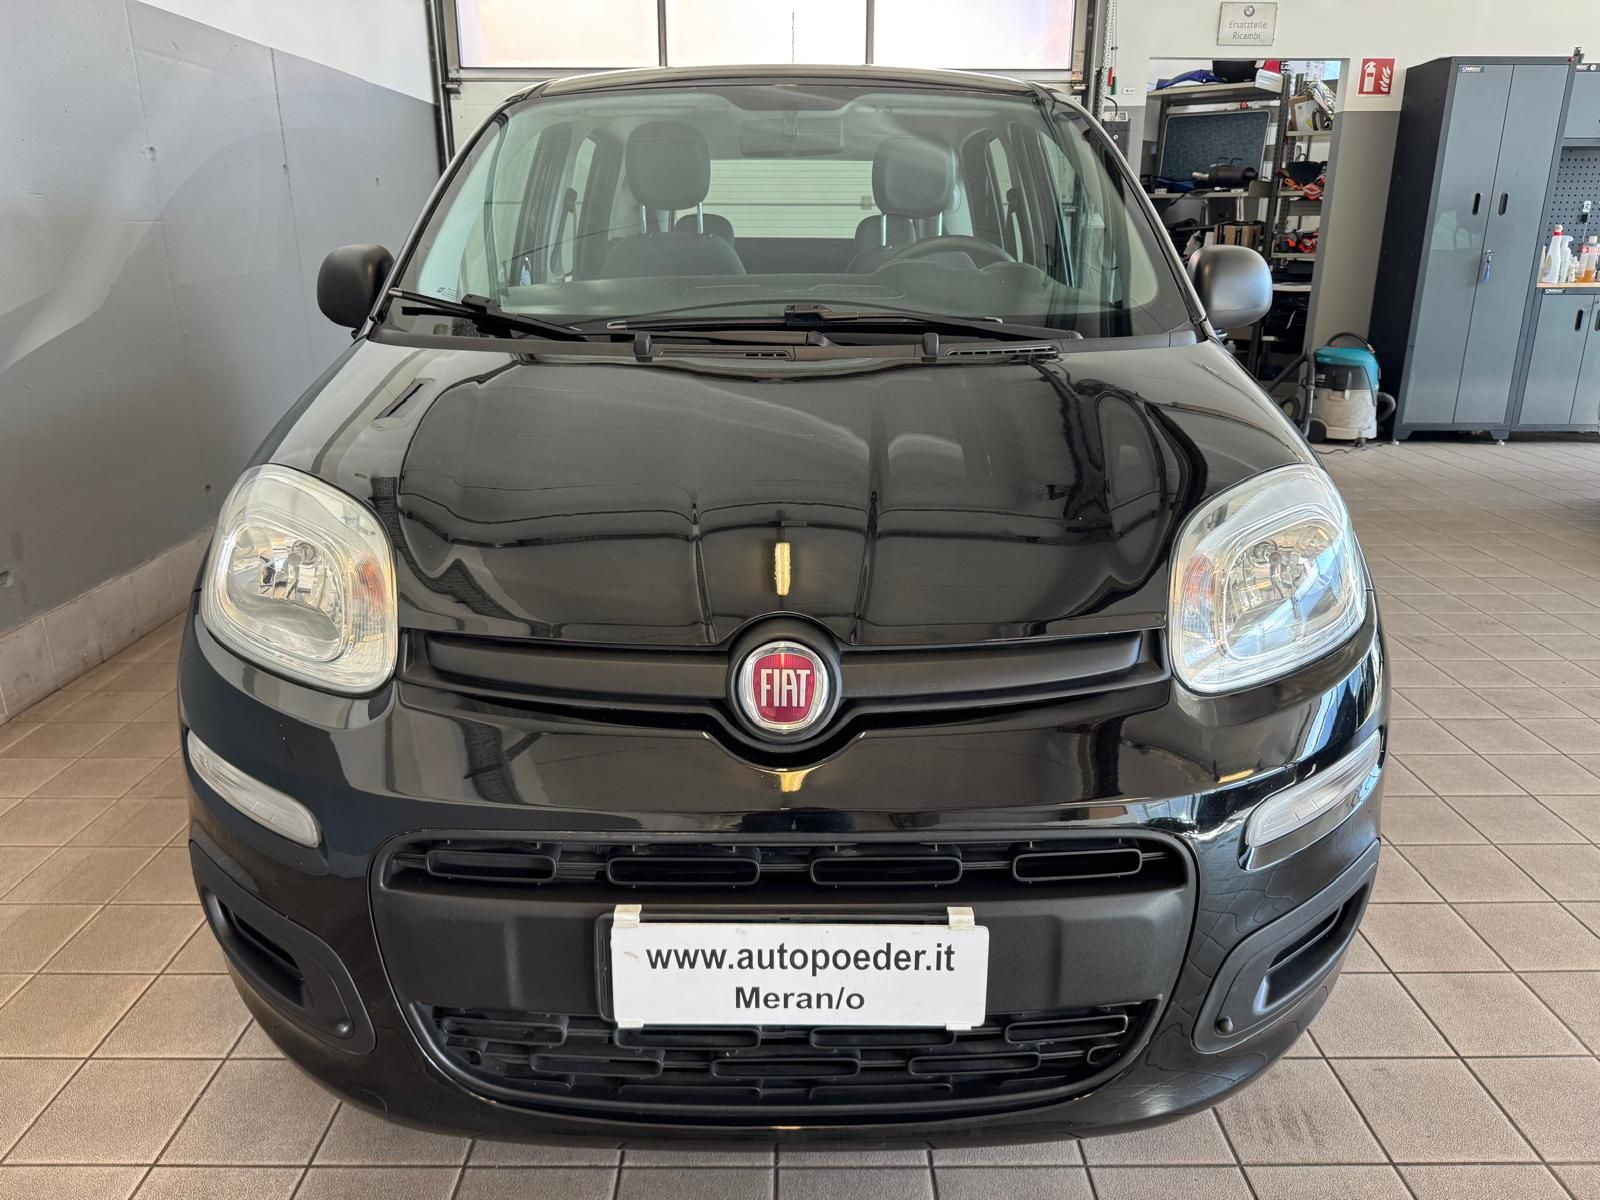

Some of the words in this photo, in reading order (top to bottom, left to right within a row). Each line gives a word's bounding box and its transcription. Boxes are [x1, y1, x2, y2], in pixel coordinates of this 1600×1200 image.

[1229, 20, 1268, 29] Ersatzteile
[1232, 31, 1261, 40] Ricambi
[760, 669, 811, 707] FIAT
[646, 943, 955, 977] www.autopoeder.it
[735, 986, 865, 1010] Meran/o
